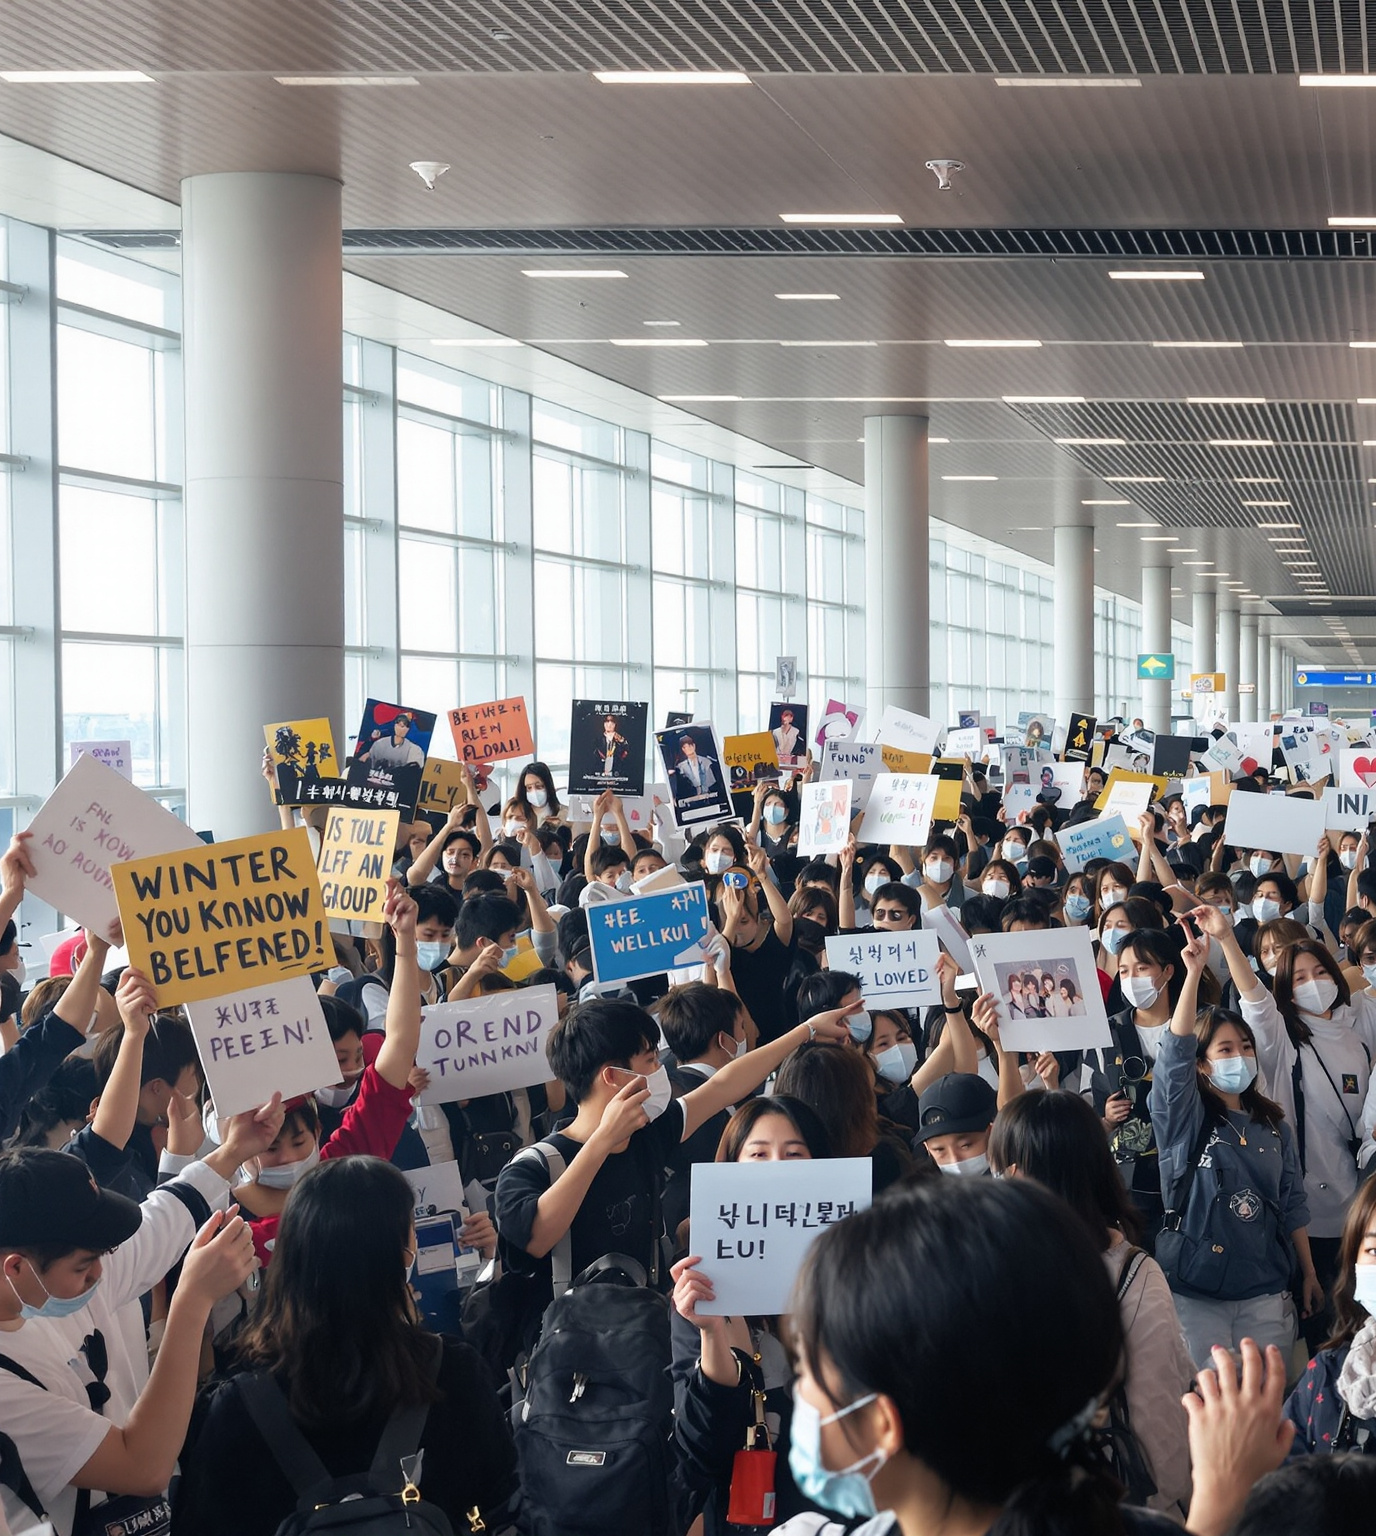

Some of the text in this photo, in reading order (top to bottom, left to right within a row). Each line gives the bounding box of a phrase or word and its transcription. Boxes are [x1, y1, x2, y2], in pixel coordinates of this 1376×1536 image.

[327, 816, 343, 842] IS
[131, 846, 297, 901] WINTER
[358, 853, 384, 879] AN
[136, 906, 190, 943] YOU
[435, 1010, 542, 1049] OREND
